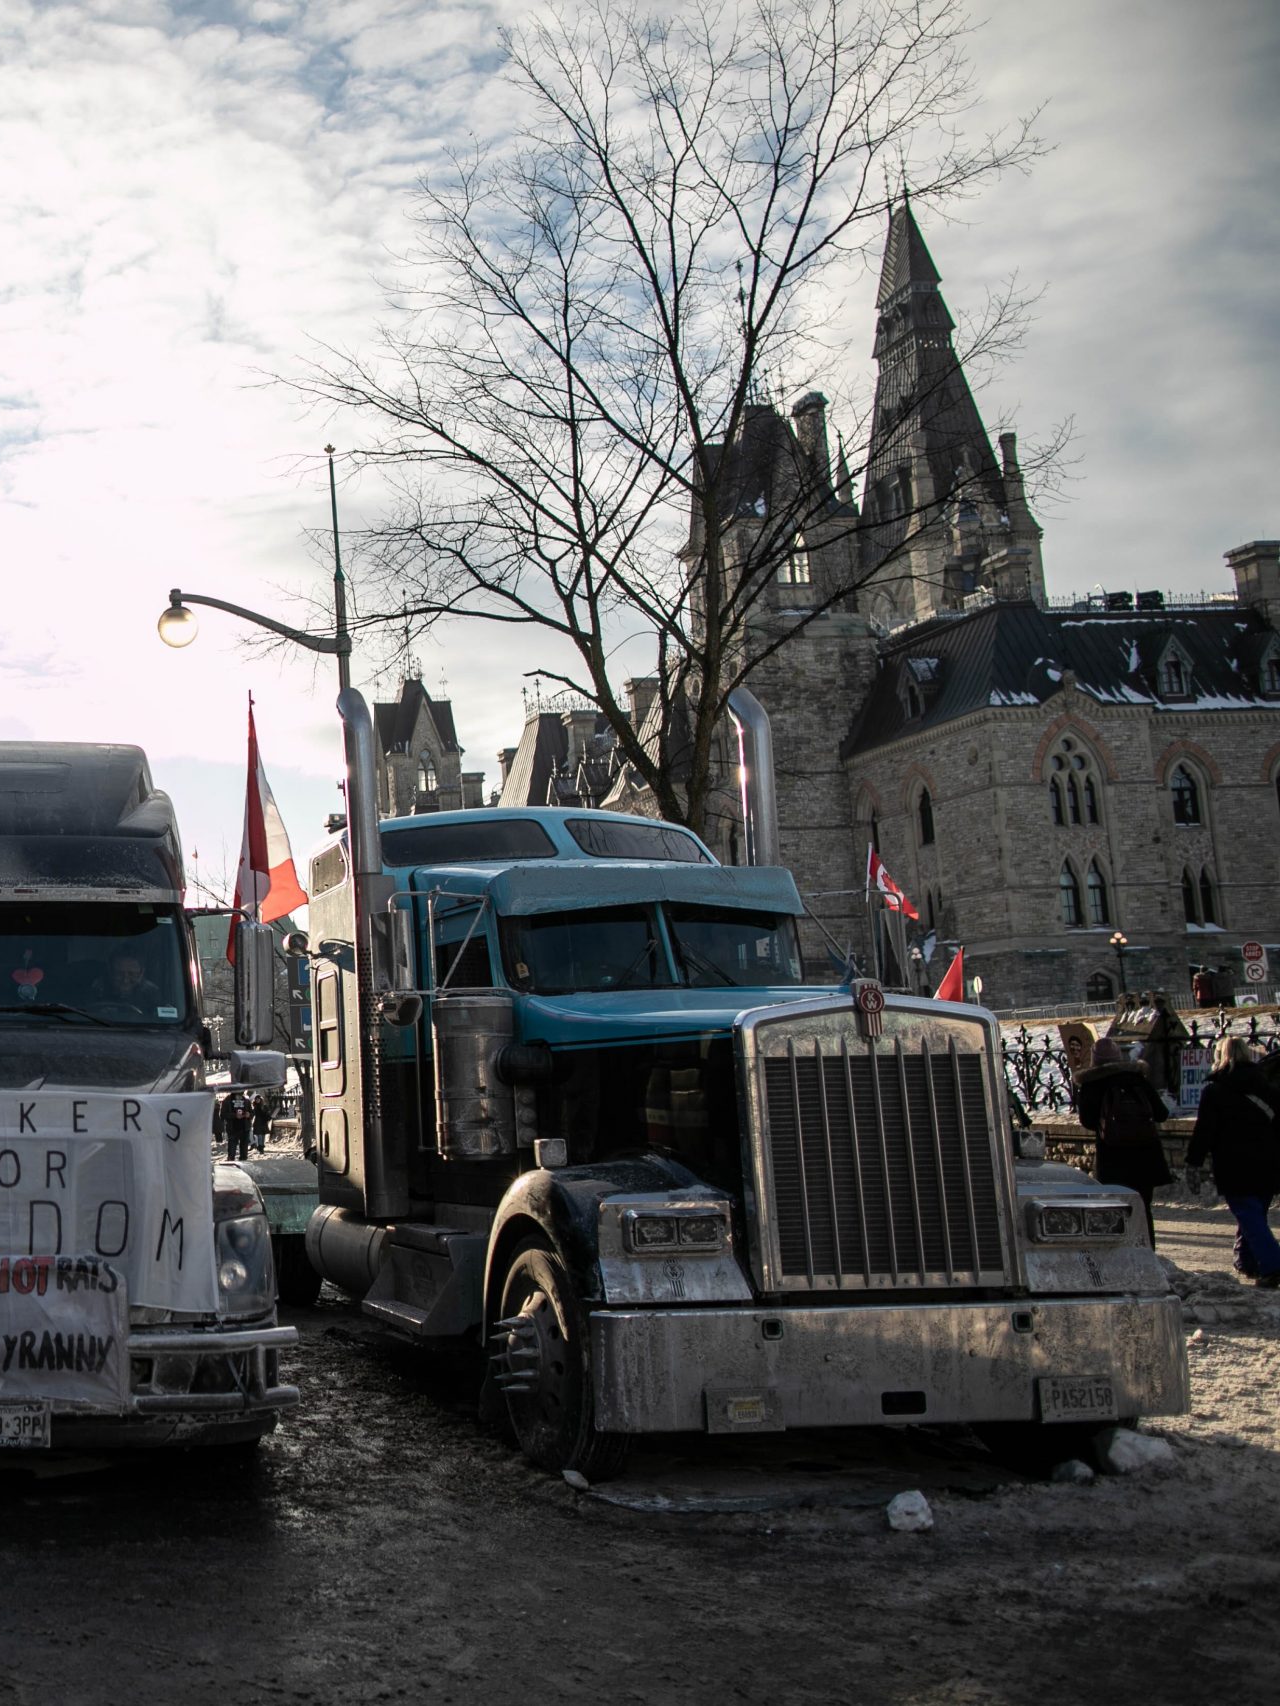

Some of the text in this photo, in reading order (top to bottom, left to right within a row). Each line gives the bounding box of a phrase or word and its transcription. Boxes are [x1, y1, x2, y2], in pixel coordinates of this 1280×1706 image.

[1182, 1050, 1203, 1066] HELP
[1181, 1088, 1200, 1104] LIFE
[57, 1256, 117, 1293] RATS
